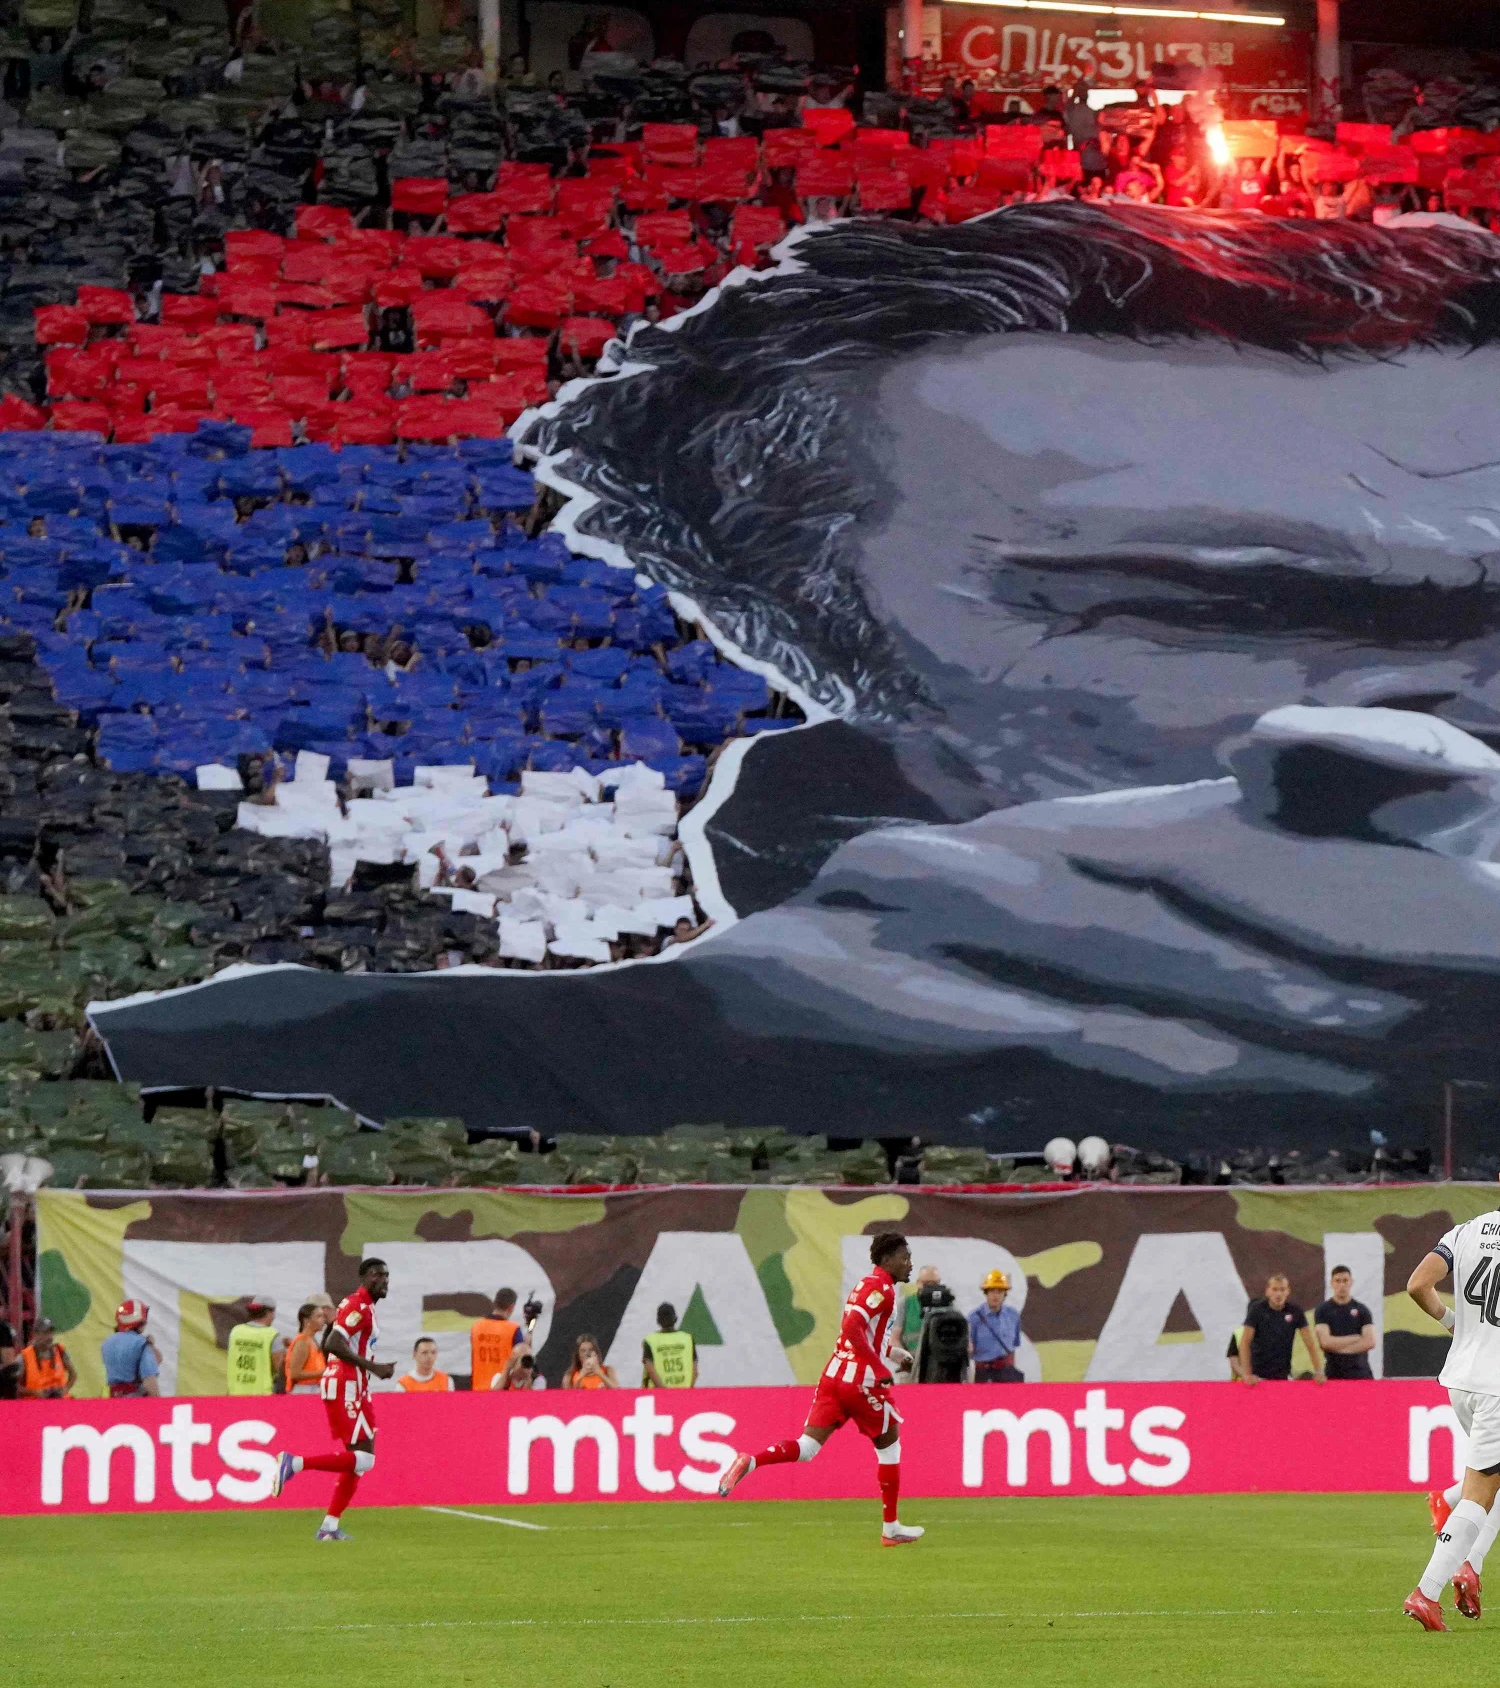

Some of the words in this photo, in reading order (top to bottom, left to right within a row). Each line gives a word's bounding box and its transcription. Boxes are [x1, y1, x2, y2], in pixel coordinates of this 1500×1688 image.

[41, 1403, 277, 1505] mts
[507, 1395, 738, 1496] mts
[961, 1389, 1191, 1488] mts
